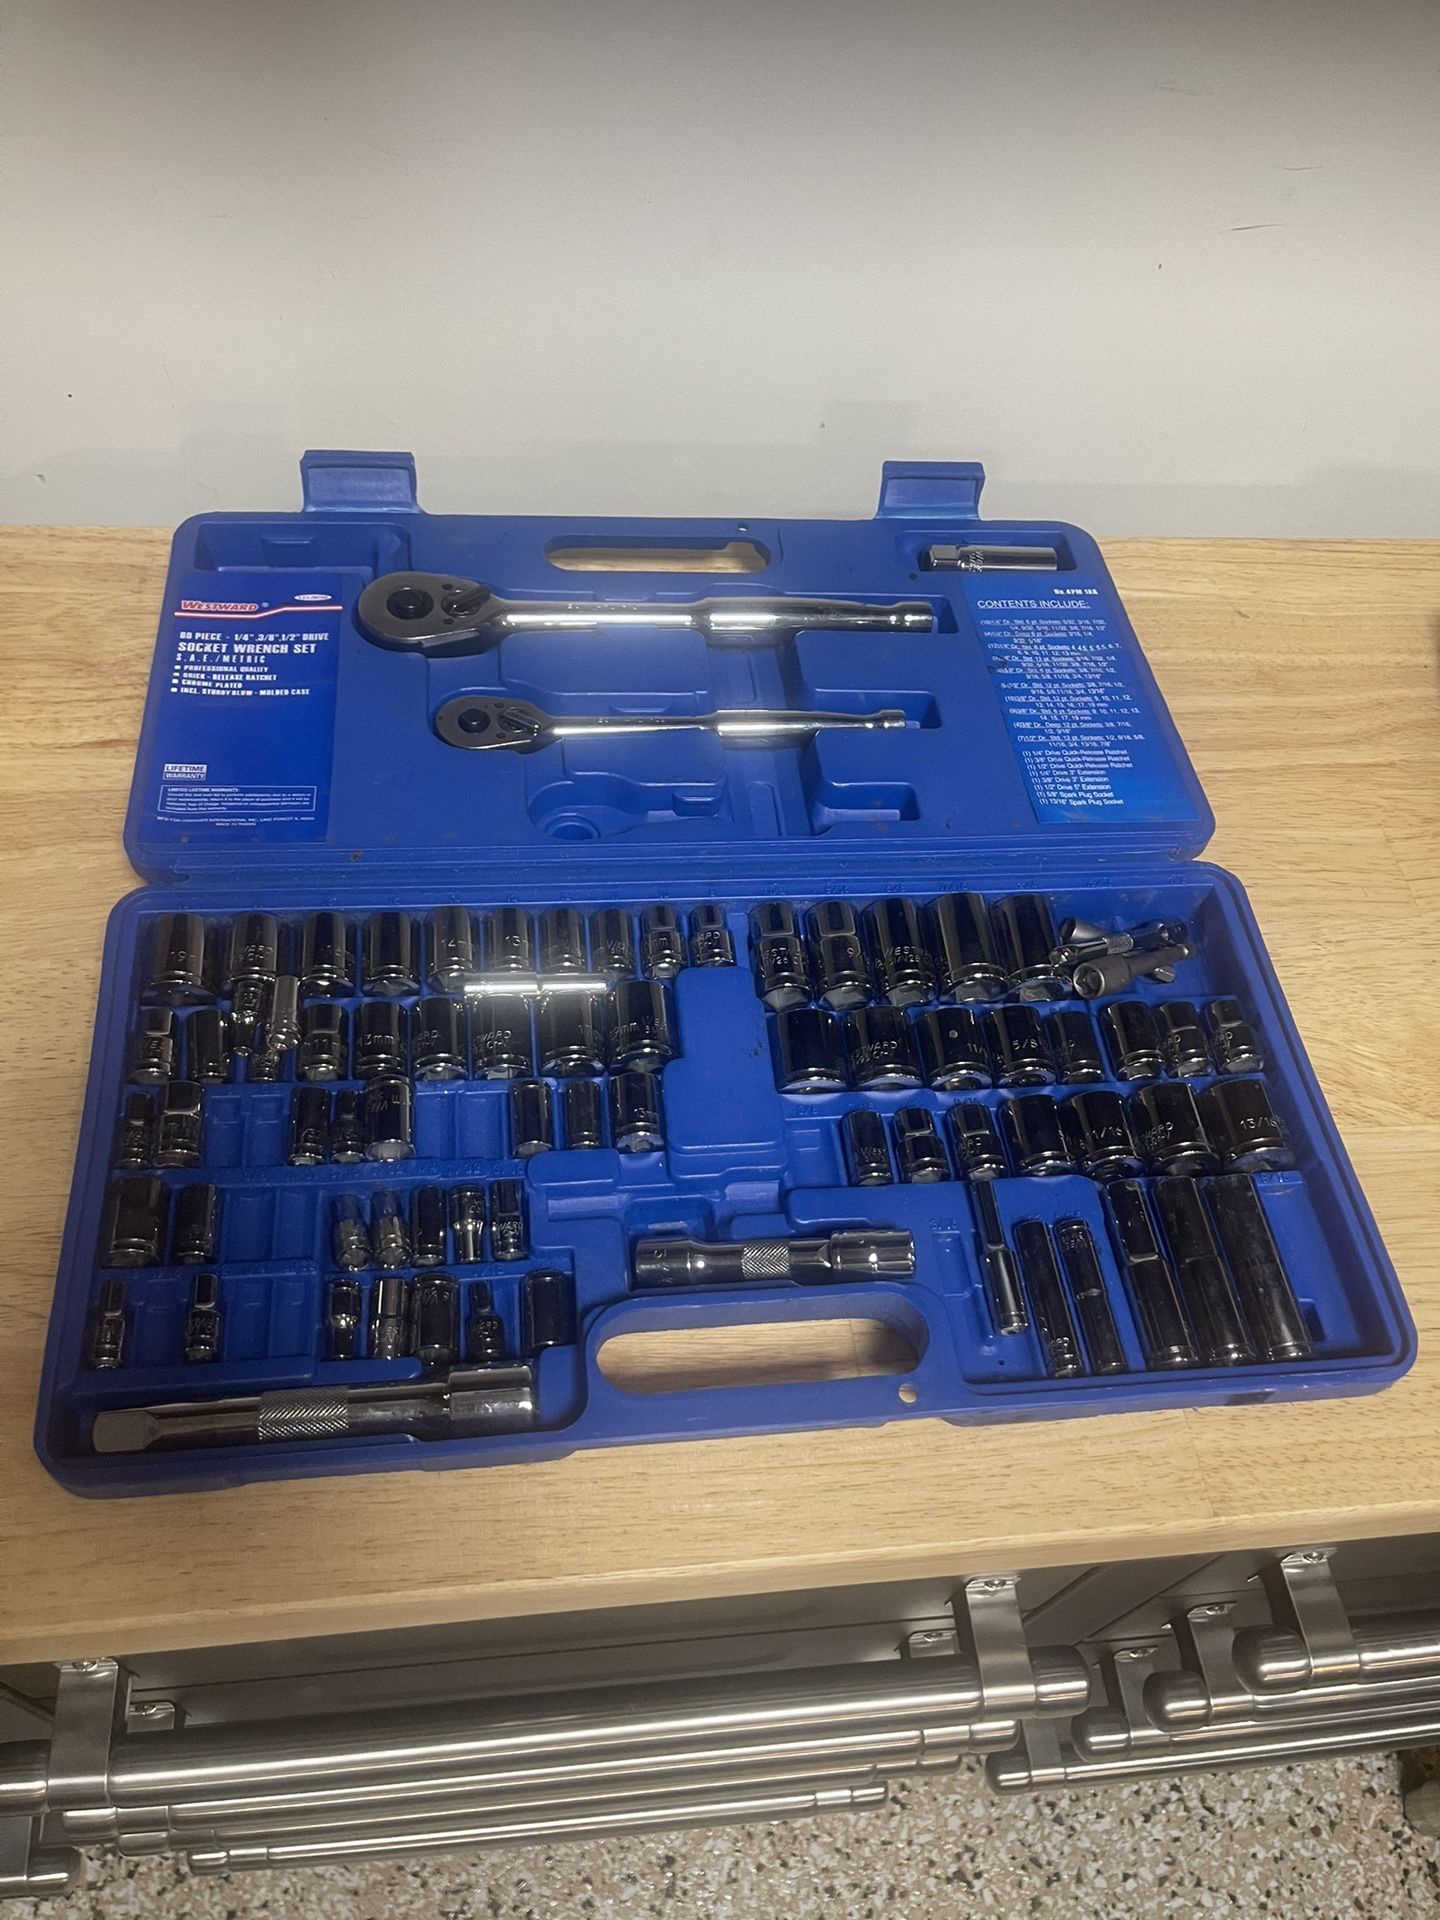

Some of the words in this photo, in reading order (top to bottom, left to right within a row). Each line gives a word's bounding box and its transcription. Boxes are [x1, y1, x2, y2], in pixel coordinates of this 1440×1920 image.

[182, 601, 257, 611] WESTWARD
[977, 599, 1037, 609] CONTENTS
[1039, 599, 1091, 609] INCLUDE:
[195, 633, 223, 641] PIECE
[302, 633, 329, 641] DRIVE
[178, 641, 228, 653] SOCKET
[233, 643, 289, 654] WRENCH
[292, 644, 317, 654] SET
[182, 679, 212, 687] CHROME
[291, 688, 311, 696] CASE
[1077, 791, 1093, 799] Plug
